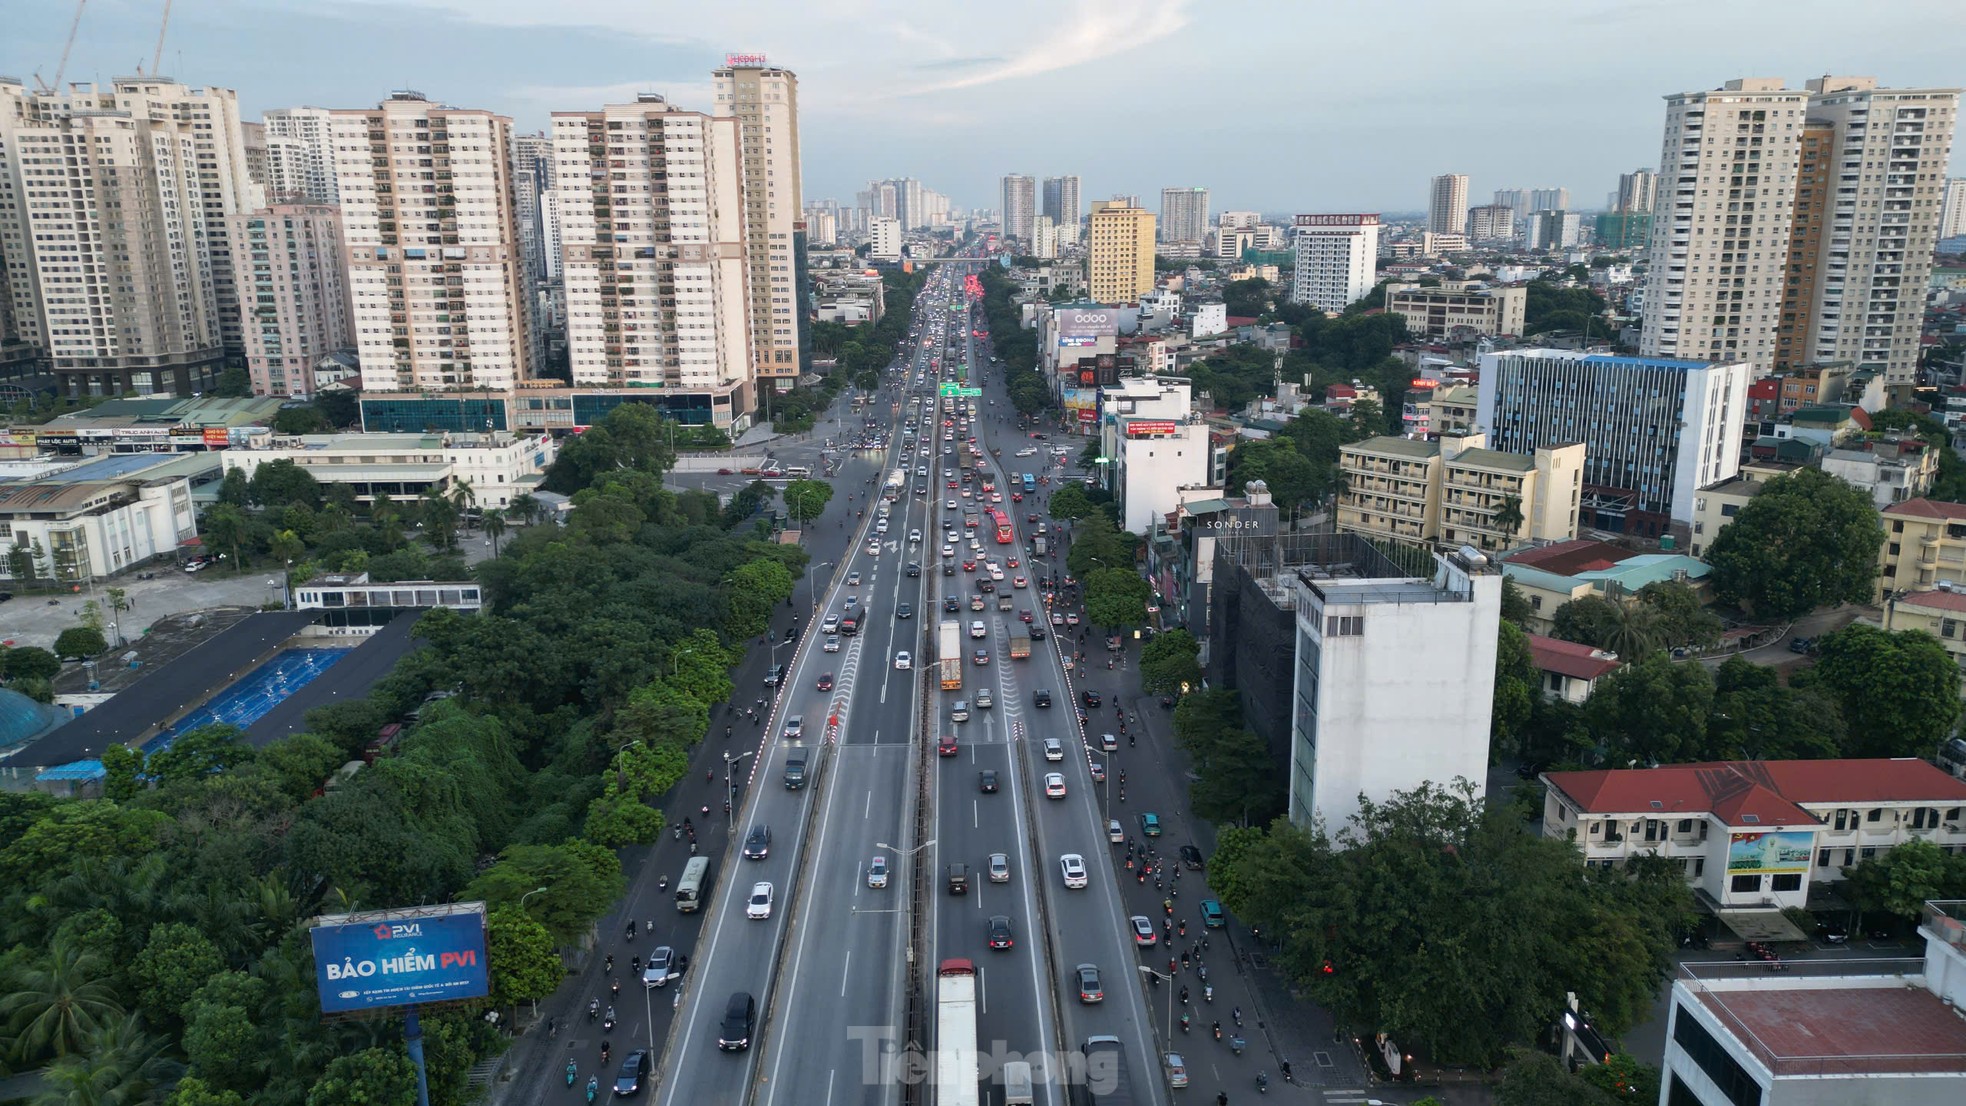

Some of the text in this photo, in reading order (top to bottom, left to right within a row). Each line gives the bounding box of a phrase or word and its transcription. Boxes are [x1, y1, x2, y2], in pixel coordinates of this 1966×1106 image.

[1075, 312, 1107, 323] odoo
[1206, 520, 1259, 529] SONDER
[392, 924, 420, 934] PVI
[326, 948, 476, 979] BẢO HIỂM PVI
